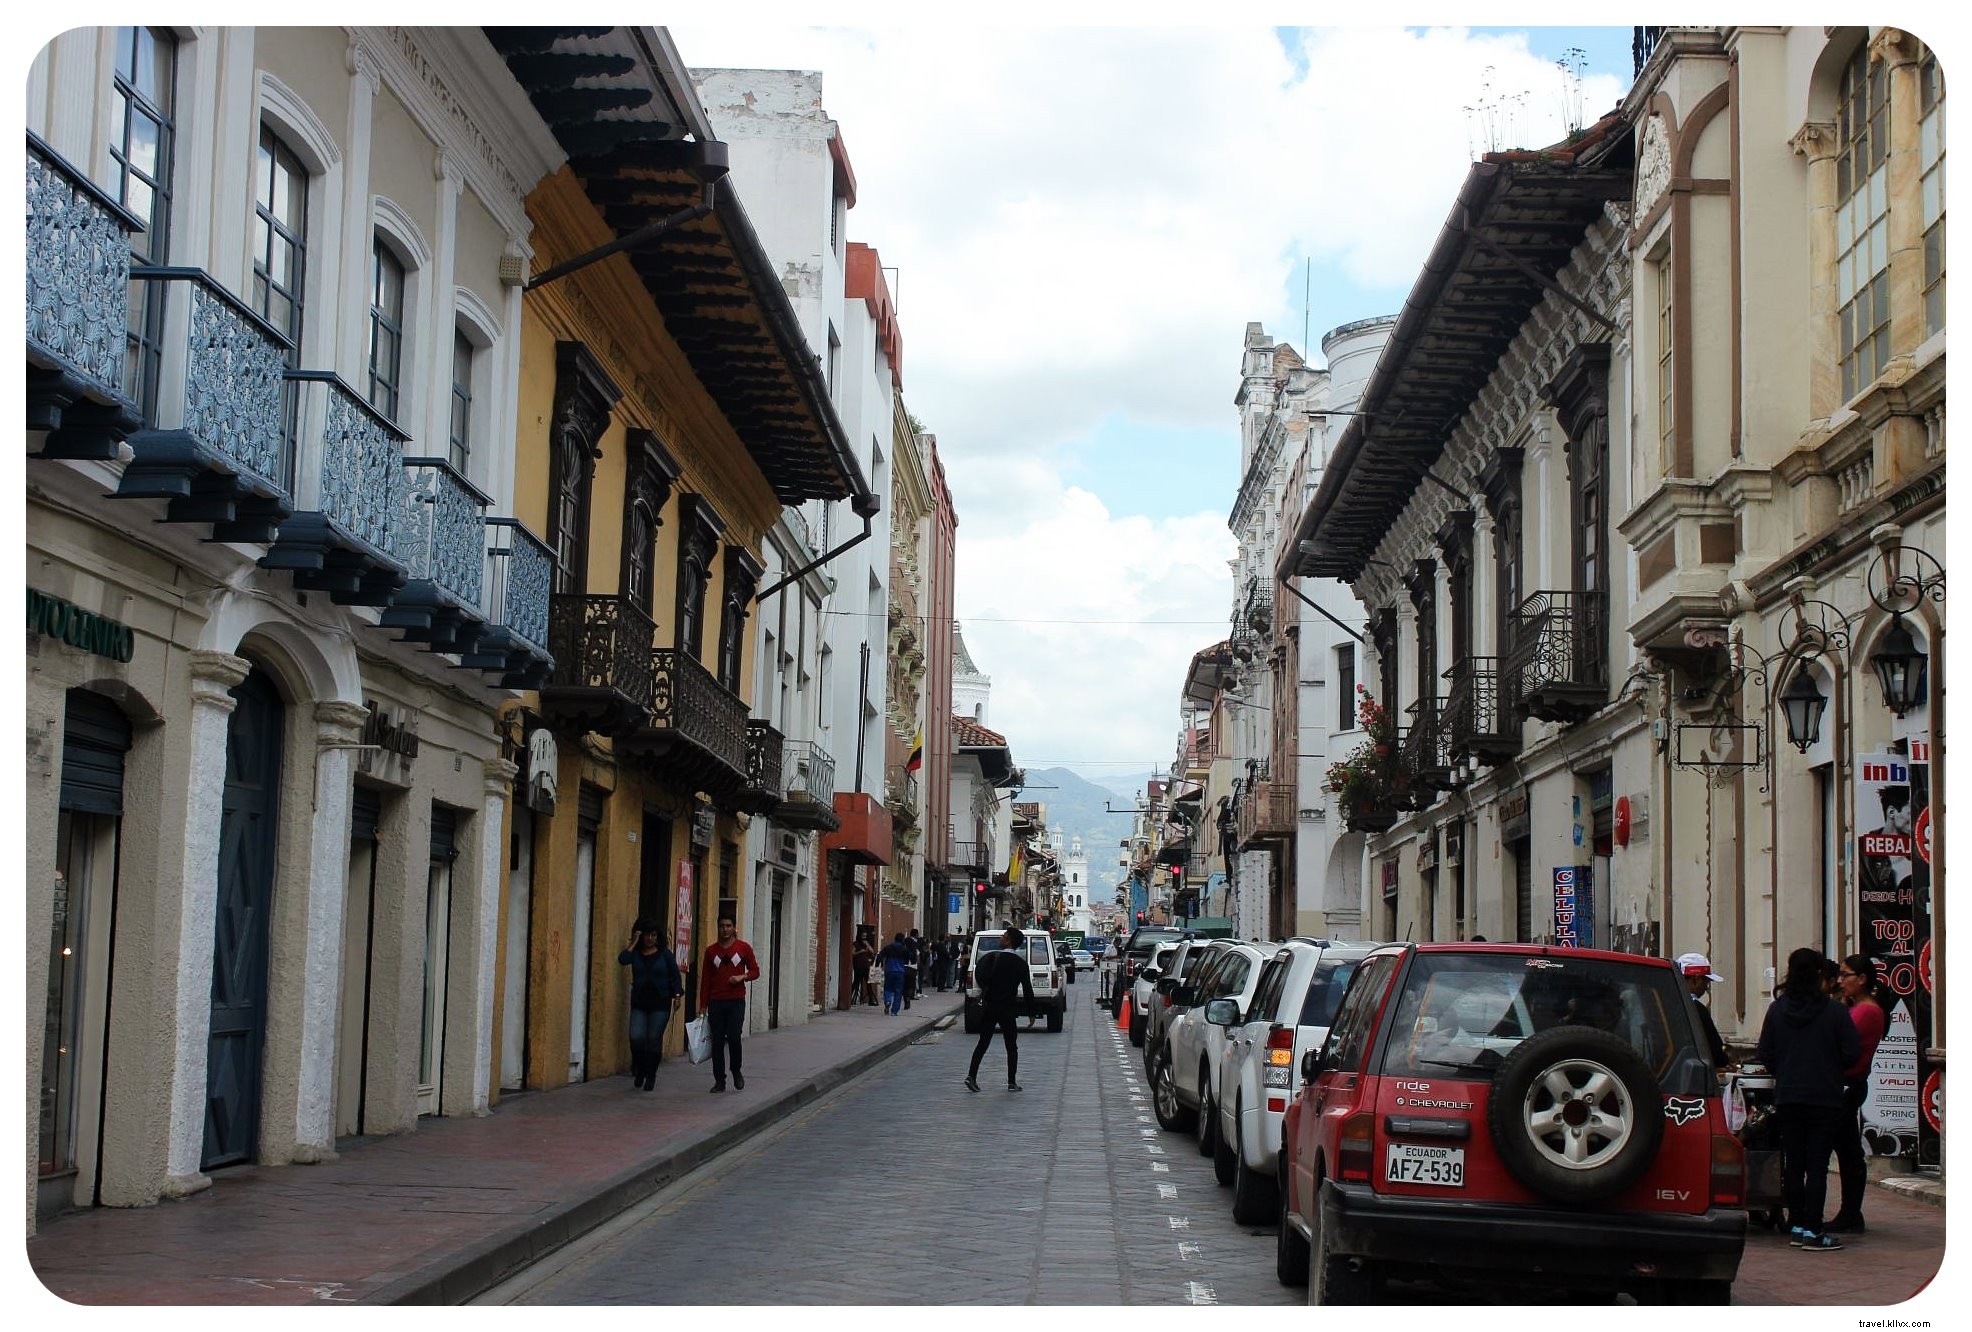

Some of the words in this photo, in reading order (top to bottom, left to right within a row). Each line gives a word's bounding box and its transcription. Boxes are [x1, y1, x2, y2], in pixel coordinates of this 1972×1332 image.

[1863, 763, 1907, 782] inb
[1861, 890, 1897, 903] DESDE
[1872, 919, 1914, 940] TOD
[1891, 940, 1911, 956] AL
[1881, 1035, 1917, 1043] OOSTER
[1396, 1081, 1430, 1091] ride
[1409, 1098, 1475, 1111] CHEVROLET
[1880, 1109, 1916, 1119] SPRING
[1405, 1147, 1447, 1159] ECUADOR
[1388, 1158, 1462, 1184] AFZ-539
